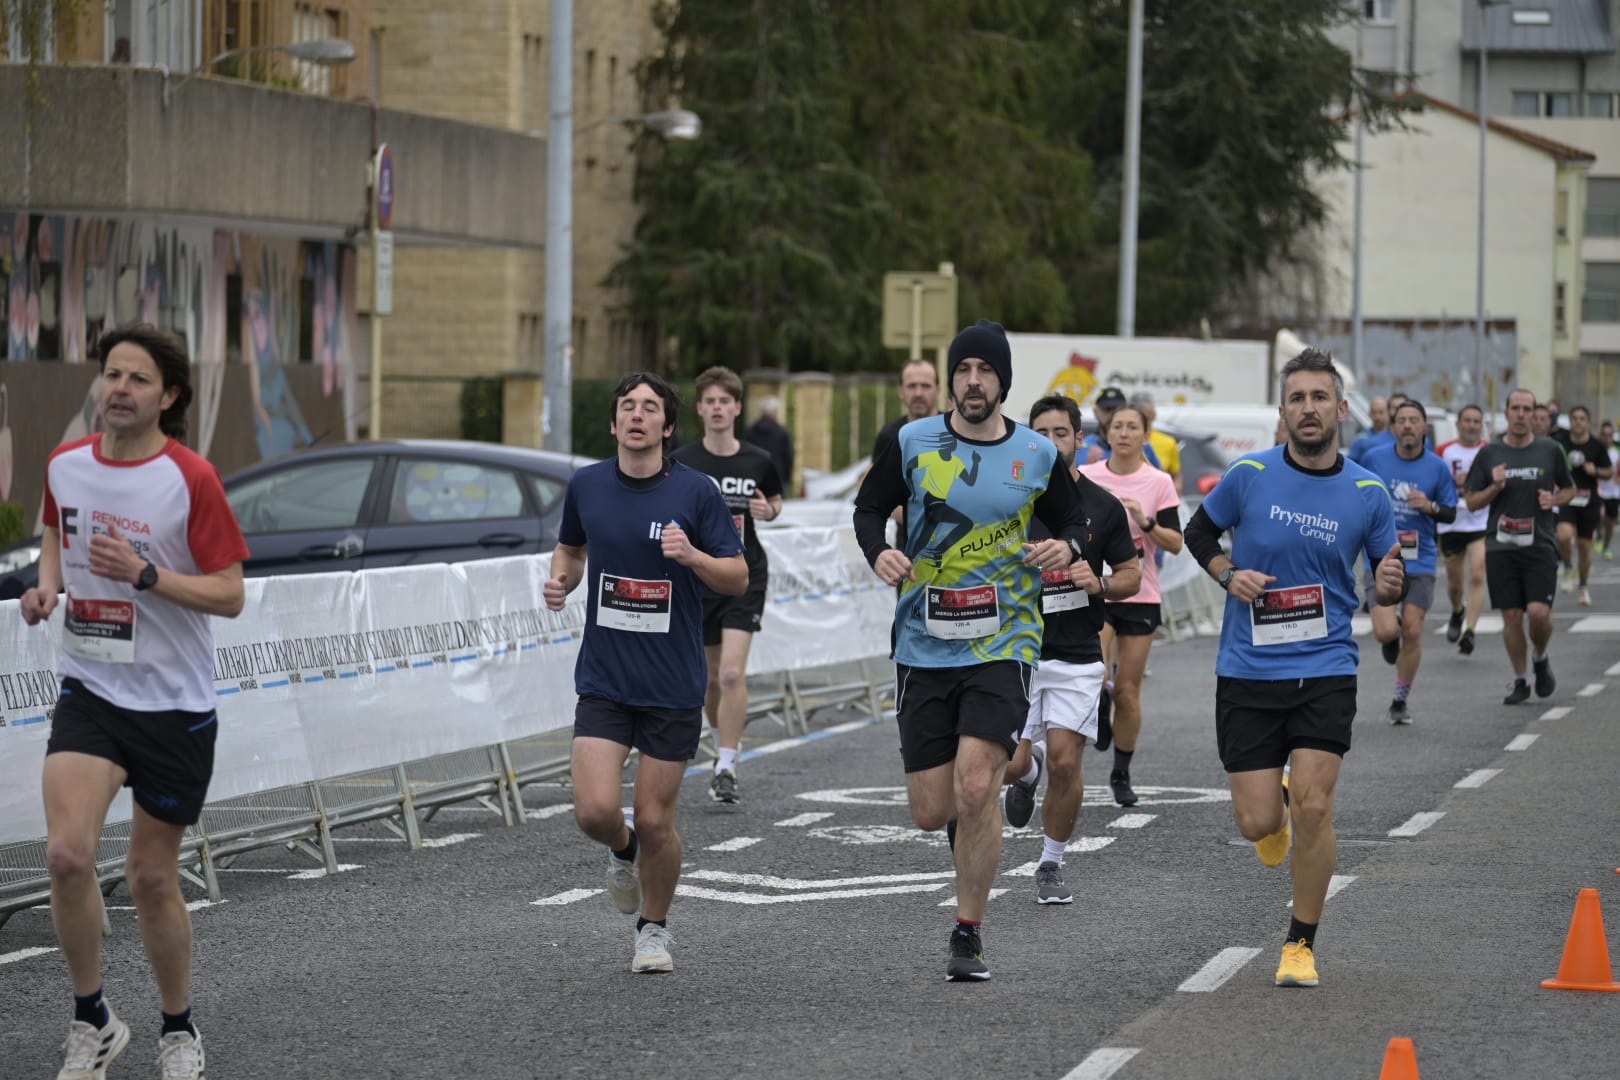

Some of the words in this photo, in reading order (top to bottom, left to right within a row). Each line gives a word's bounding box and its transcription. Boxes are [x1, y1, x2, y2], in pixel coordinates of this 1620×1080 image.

[721, 477, 756, 496] CIC
[92, 510, 152, 535] REINOSA
[1269, 505, 1339, 532] Prysmian
[1300, 525, 1336, 546] Group
[604, 581, 615, 592] 5K
[930, 593, 940, 604] 5K
